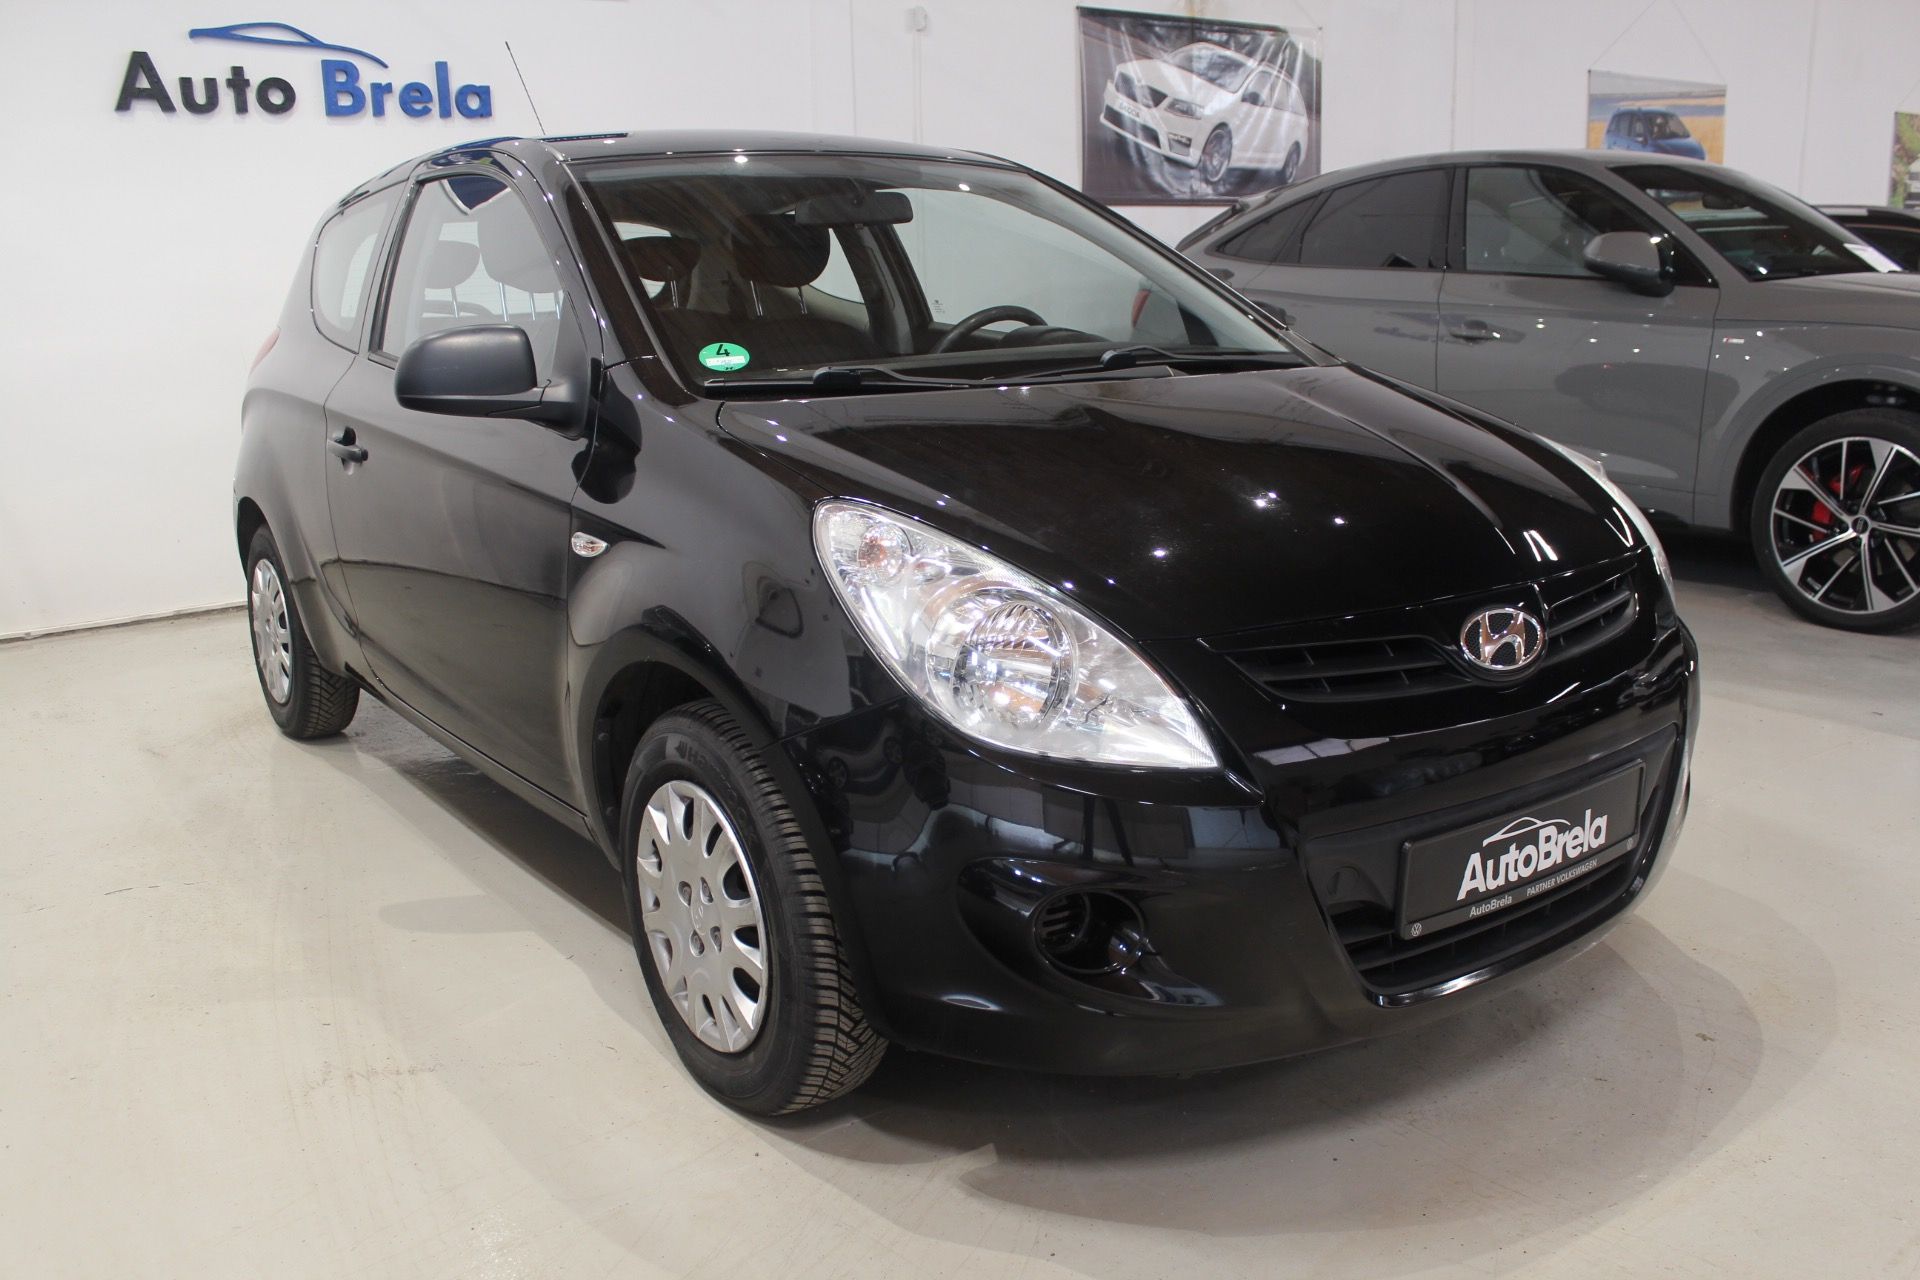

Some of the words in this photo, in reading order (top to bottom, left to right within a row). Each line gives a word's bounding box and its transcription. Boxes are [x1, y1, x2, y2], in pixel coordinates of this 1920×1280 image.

[114, 50, 297, 115] Auto
[320, 59, 493, 119] Brela
[716, 344, 730, 356] 4
[1457, 808, 1608, 901] AutoBrela
[1469, 895, 1512, 917] AutoBrela
[1526, 879, 1555, 897] PARTNER
[1556, 859, 1597, 884] VOLKSWAGEN
